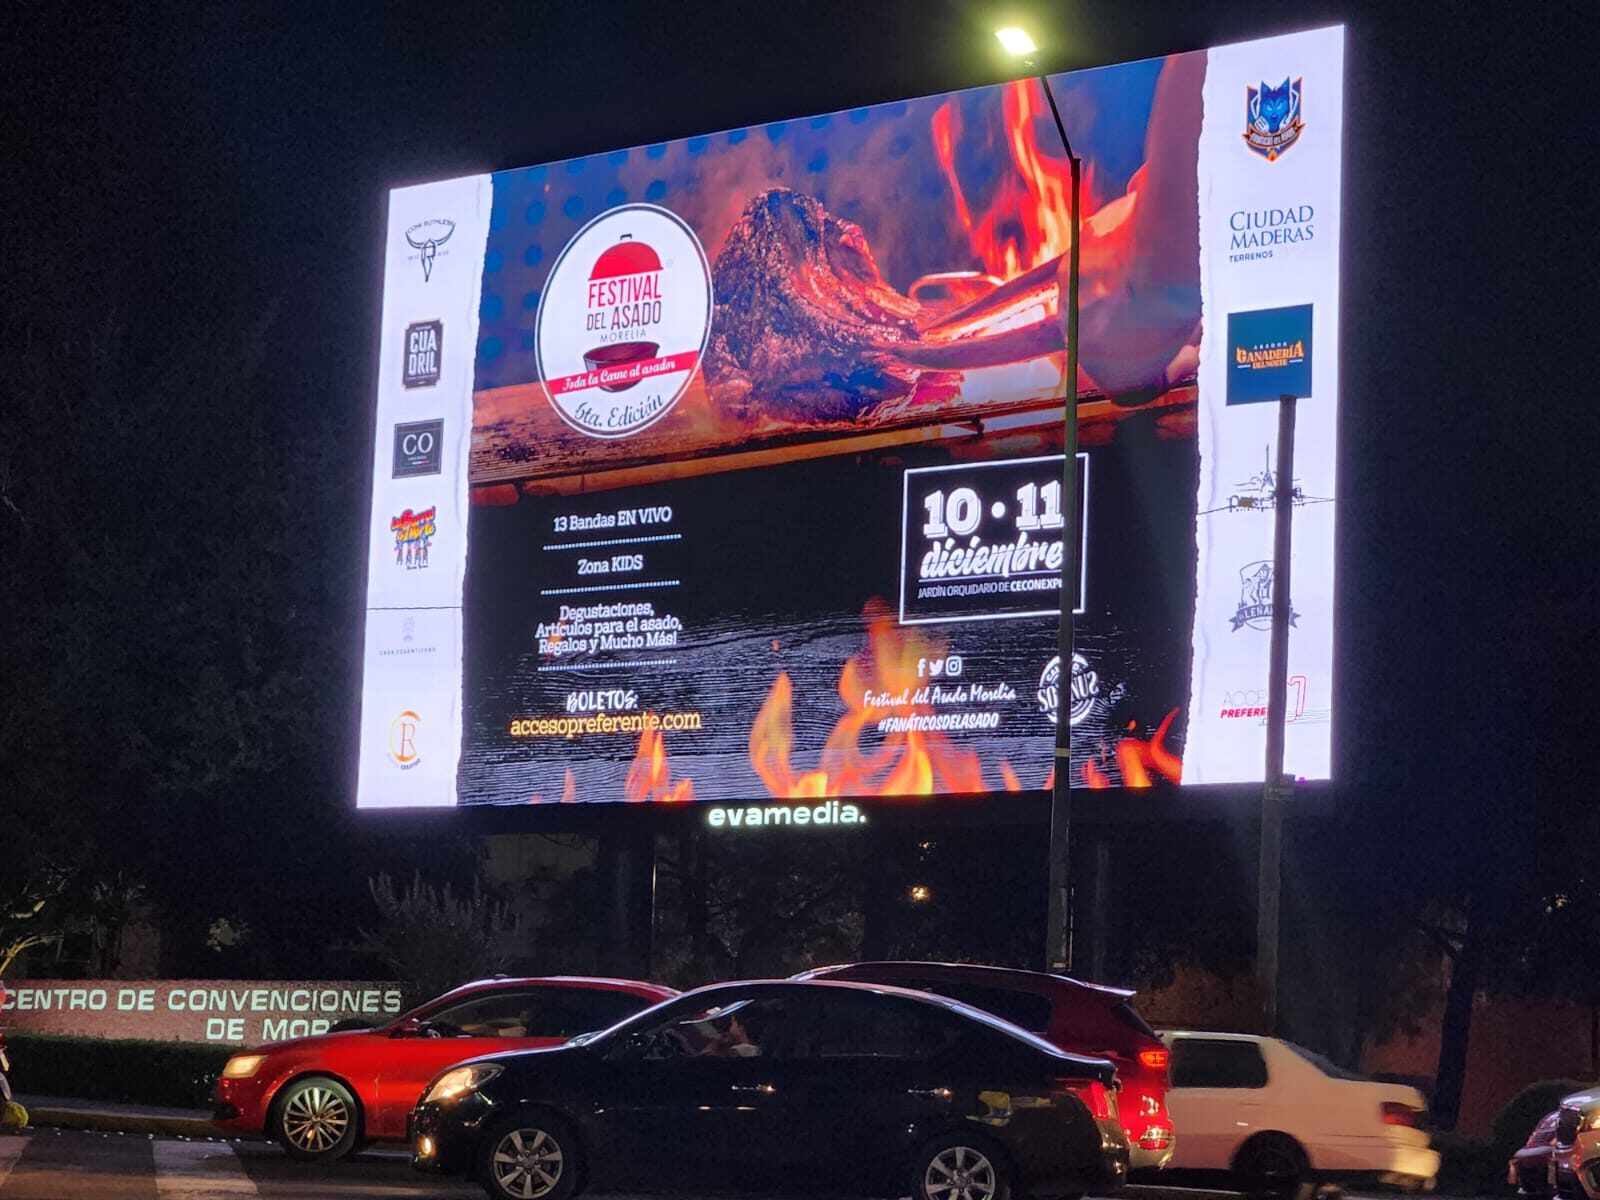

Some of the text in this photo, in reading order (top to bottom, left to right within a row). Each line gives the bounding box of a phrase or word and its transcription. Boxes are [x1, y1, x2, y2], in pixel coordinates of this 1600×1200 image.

[1229, 205, 1314, 231] CIUDAD
[1229, 224, 1314, 251] MADERAS
[1229, 250, 1273, 263] TERRENOS
[588, 273, 662, 308] FESTIVAL
[586, 300, 661, 331] DEL ASADO
[409, 329, 438, 353] CUA
[599, 329, 647, 344] MORELIA
[407, 350, 438, 376] DRIL
[562, 359, 677, 392] Toda la Carne al asador
[574, 394, 664, 428] 5ta. Edición
[403, 432, 433, 455] CO
[553, 506, 672, 532] 13 Bandas EN VIVO
[923, 480, 1064, 539] 10 11
[577, 554, 643, 575] Zona KIDS
[920, 532, 1064, 578] diciembre
[917, 584, 946, 599] JARDÍN
[947, 582, 998, 597] ORQUIDARIO
[998, 581, 1010, 593] DE
[559, 602, 655, 623] Degustaciones,
[534, 614, 683, 639] Artículos para el asado,
[538, 631, 677, 655] Regalos y Mucho Más!
[566, 689, 639, 713] BOLETOS:
[863, 682, 1017, 708] Festival del Asado Morelia
[1223, 689, 1266, 707] ACCE
[877, 712, 999, 733] #FANÁTICOSDELASADO
[1220, 707, 1267, 718] PREFERE
[510, 711, 702, 739] accesopreferente.com
[1, 988, 401, 1012] CENTRO DE CONVENCIONES
[206, 1018, 245, 1041] DE
